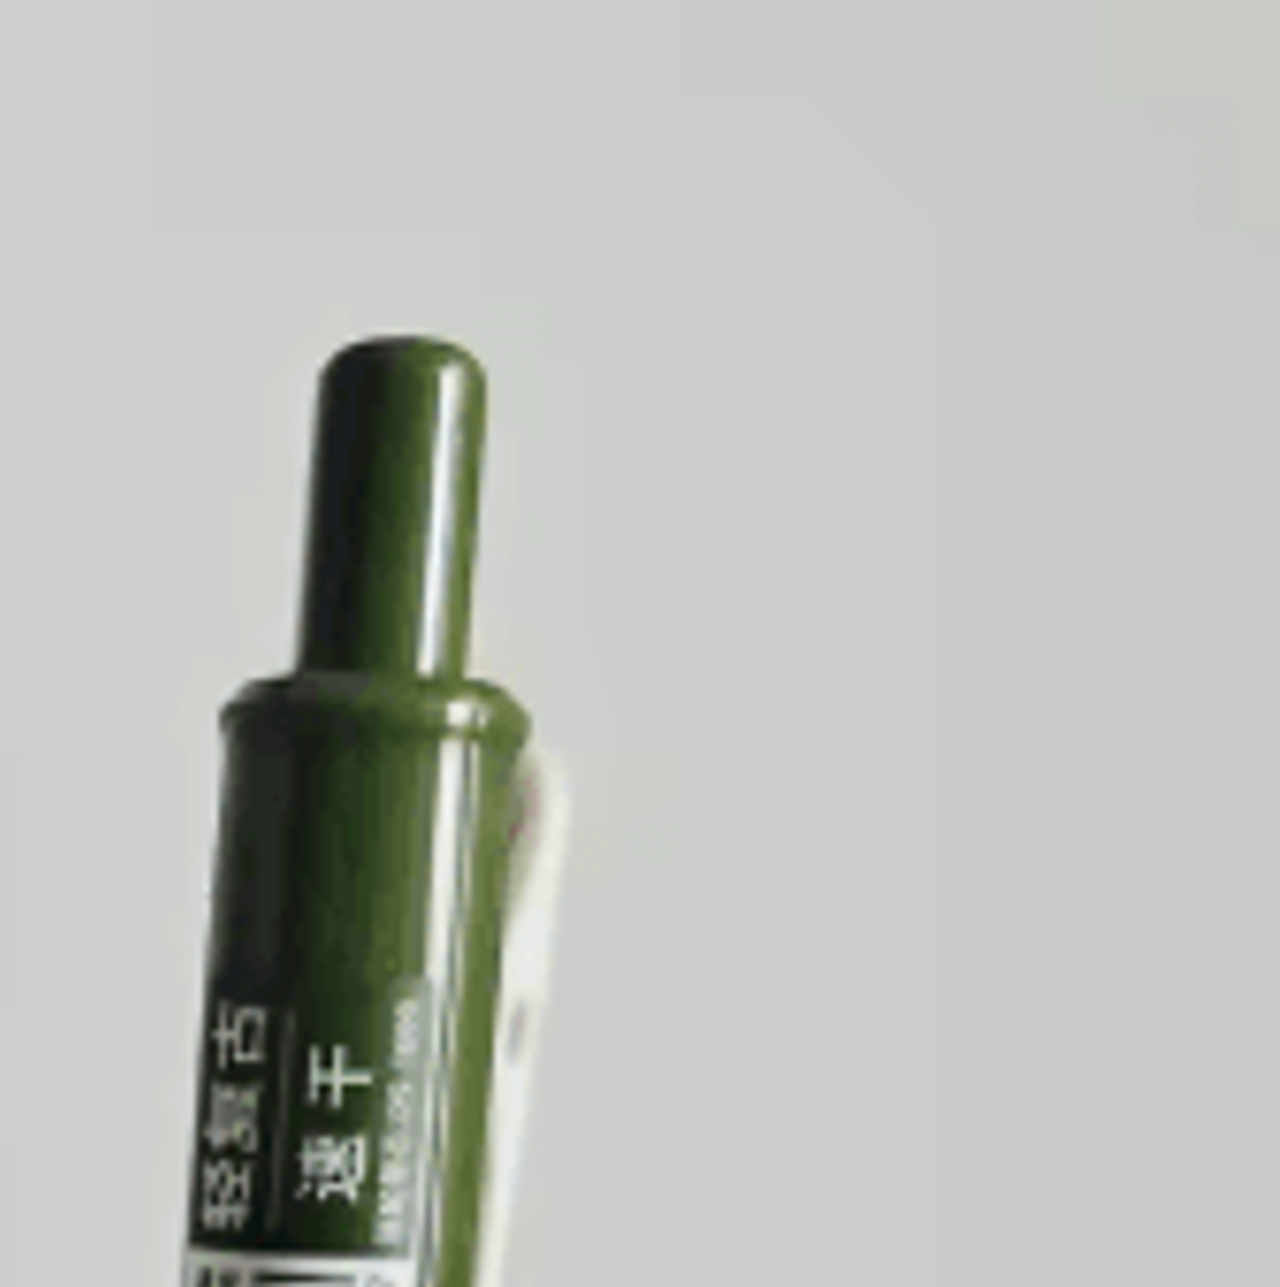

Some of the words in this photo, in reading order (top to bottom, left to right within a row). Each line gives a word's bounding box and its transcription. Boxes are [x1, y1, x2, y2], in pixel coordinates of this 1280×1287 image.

[201, 1000, 267, 1231] 轻复古
[294, 1044, 373, 1205] 速干
